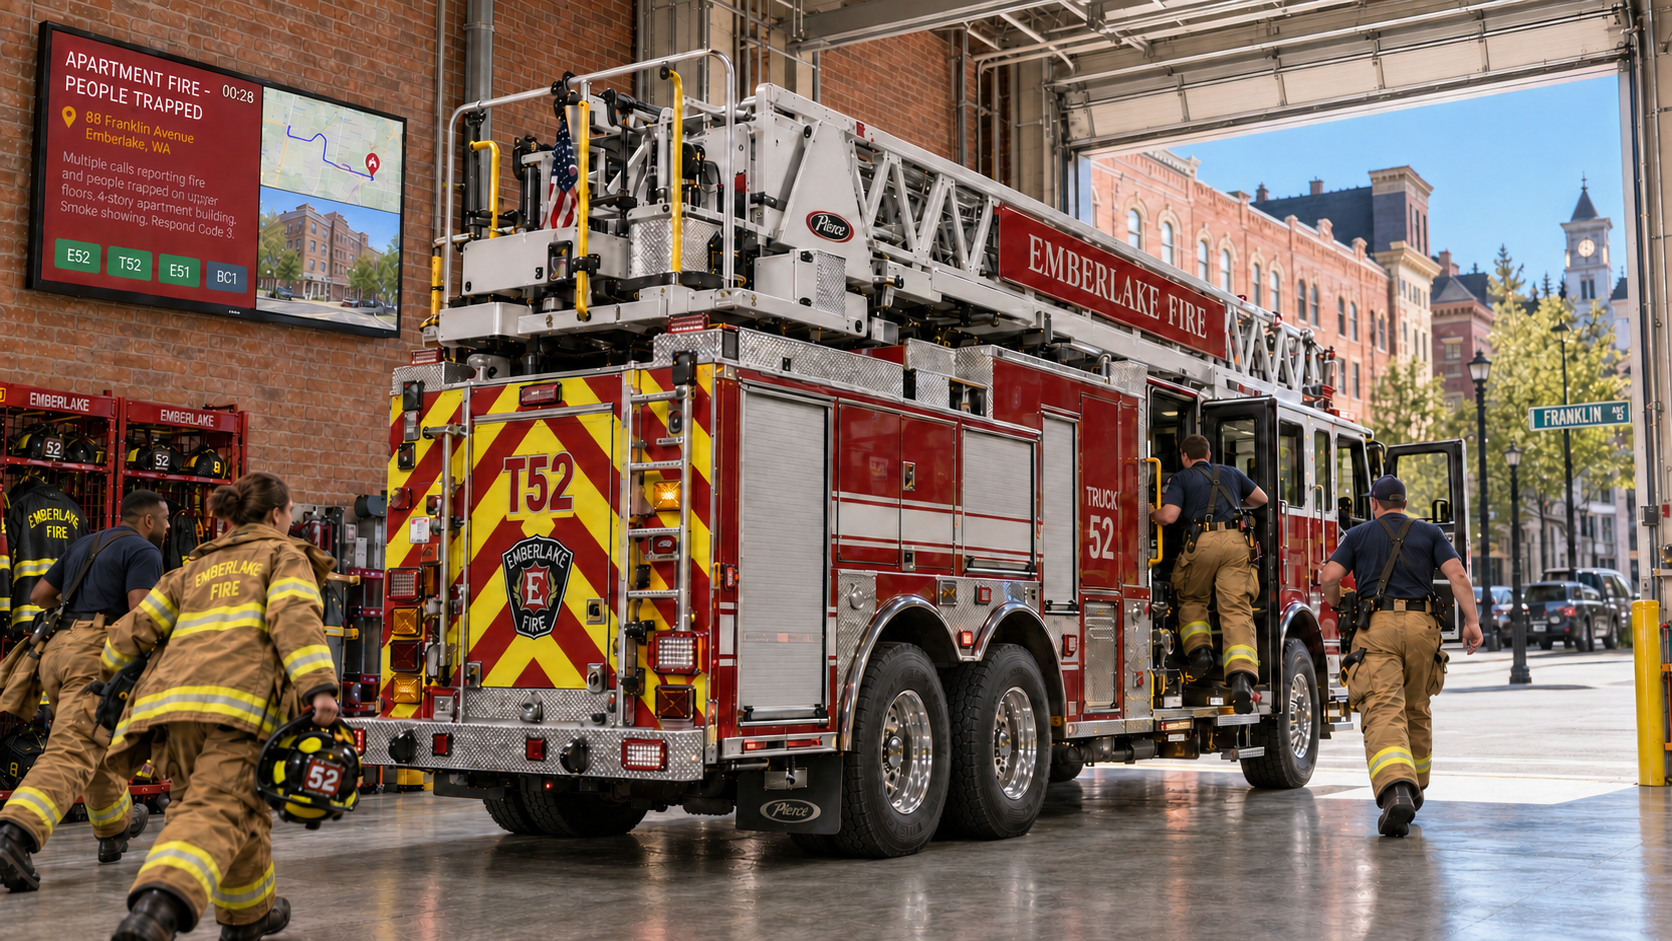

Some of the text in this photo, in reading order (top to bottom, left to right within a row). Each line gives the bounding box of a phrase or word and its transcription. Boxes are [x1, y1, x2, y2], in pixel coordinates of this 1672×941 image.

[65, 51, 164, 88] APARTMENT
[168, 75, 200, 97] FIRE
[65, 75, 203, 120] PEOPLE TRAPPED
[222, 84, 254, 104] 00:28
[85, 111, 195, 144] 88 Franklin Avenue
[85, 127, 171, 155] Emberlake, WA
[62, 151, 206, 188] Multiple calls reporting fire
[61, 169, 83, 182] and
[86, 173, 125, 190] people
[171, 190, 185, 200] on
[60, 200, 235, 240] Smoke showing. Respond Code 3.
[136, 198, 193, 217] apartment
[195, 207, 237, 227] building.
[815, 215, 846, 236] Pierce
[67, 248, 91, 265] E52
[118, 256, 141, 272] T52
[170, 263, 190, 279] E51
[216, 270, 237, 285] BC1
[1028, 233, 1208, 339] EMBERLAKE FIRE
[29, 392, 90, 412] EMBERLAKE
[160, 409, 214, 428] EMBERLAKE
[1544, 406, 1602, 426] FRANKLIN
[46, 441, 61, 455] 52
[155, 453, 169, 467] 52
[502, 451, 575, 514] T52
[1086, 485, 1118, 511] TRUCK
[28, 508, 80, 530] EMBERLAKE
[46, 525, 69, 539] FIRE
[1088, 514, 1114, 560] 52
[506, 543, 569, 570] EMBERLAKE
[195, 560, 264, 588] EMBERLAKE
[210, 580, 241, 601] FIRE
[525, 571, 545, 606] E
[521, 615, 547, 633] FIRE
[307, 765, 339, 792] 52
[771, 802, 809, 818] Pierce
